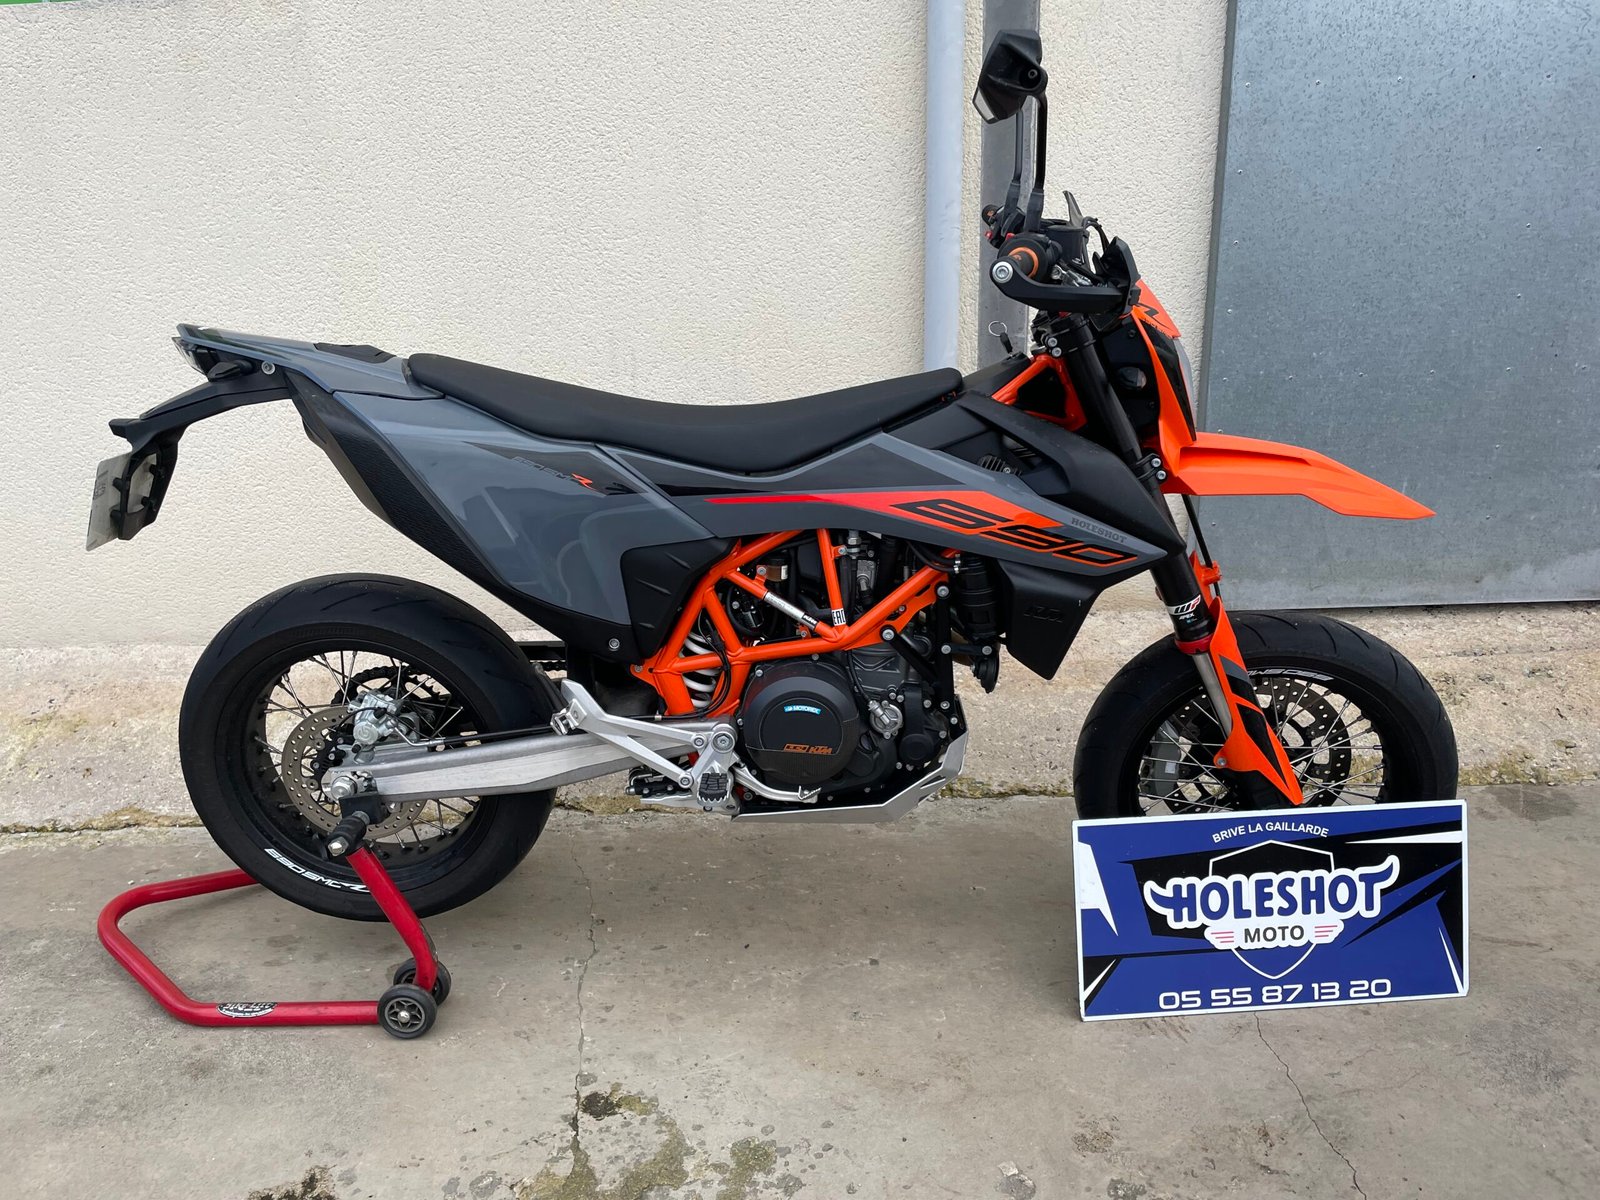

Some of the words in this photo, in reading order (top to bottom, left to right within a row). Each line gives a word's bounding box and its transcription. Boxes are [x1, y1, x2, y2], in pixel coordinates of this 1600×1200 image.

[1071, 517, 1127, 543] HOLESHOT
[1212, 825, 1246, 843] BRIVE
[1248, 823, 1263, 833] LA
[1265, 821, 1329, 838] GAILLARDE
[1150, 862, 1393, 923] HOLESHOT
[1244, 925, 1305, 944] MOTO
[1159, 990, 1201, 1009] 05
[1211, 988, 1252, 1006] 55
[1262, 984, 1303, 1003] 87
[1312, 982, 1340, 1000] 13
[1350, 979, 1391, 997] 20
